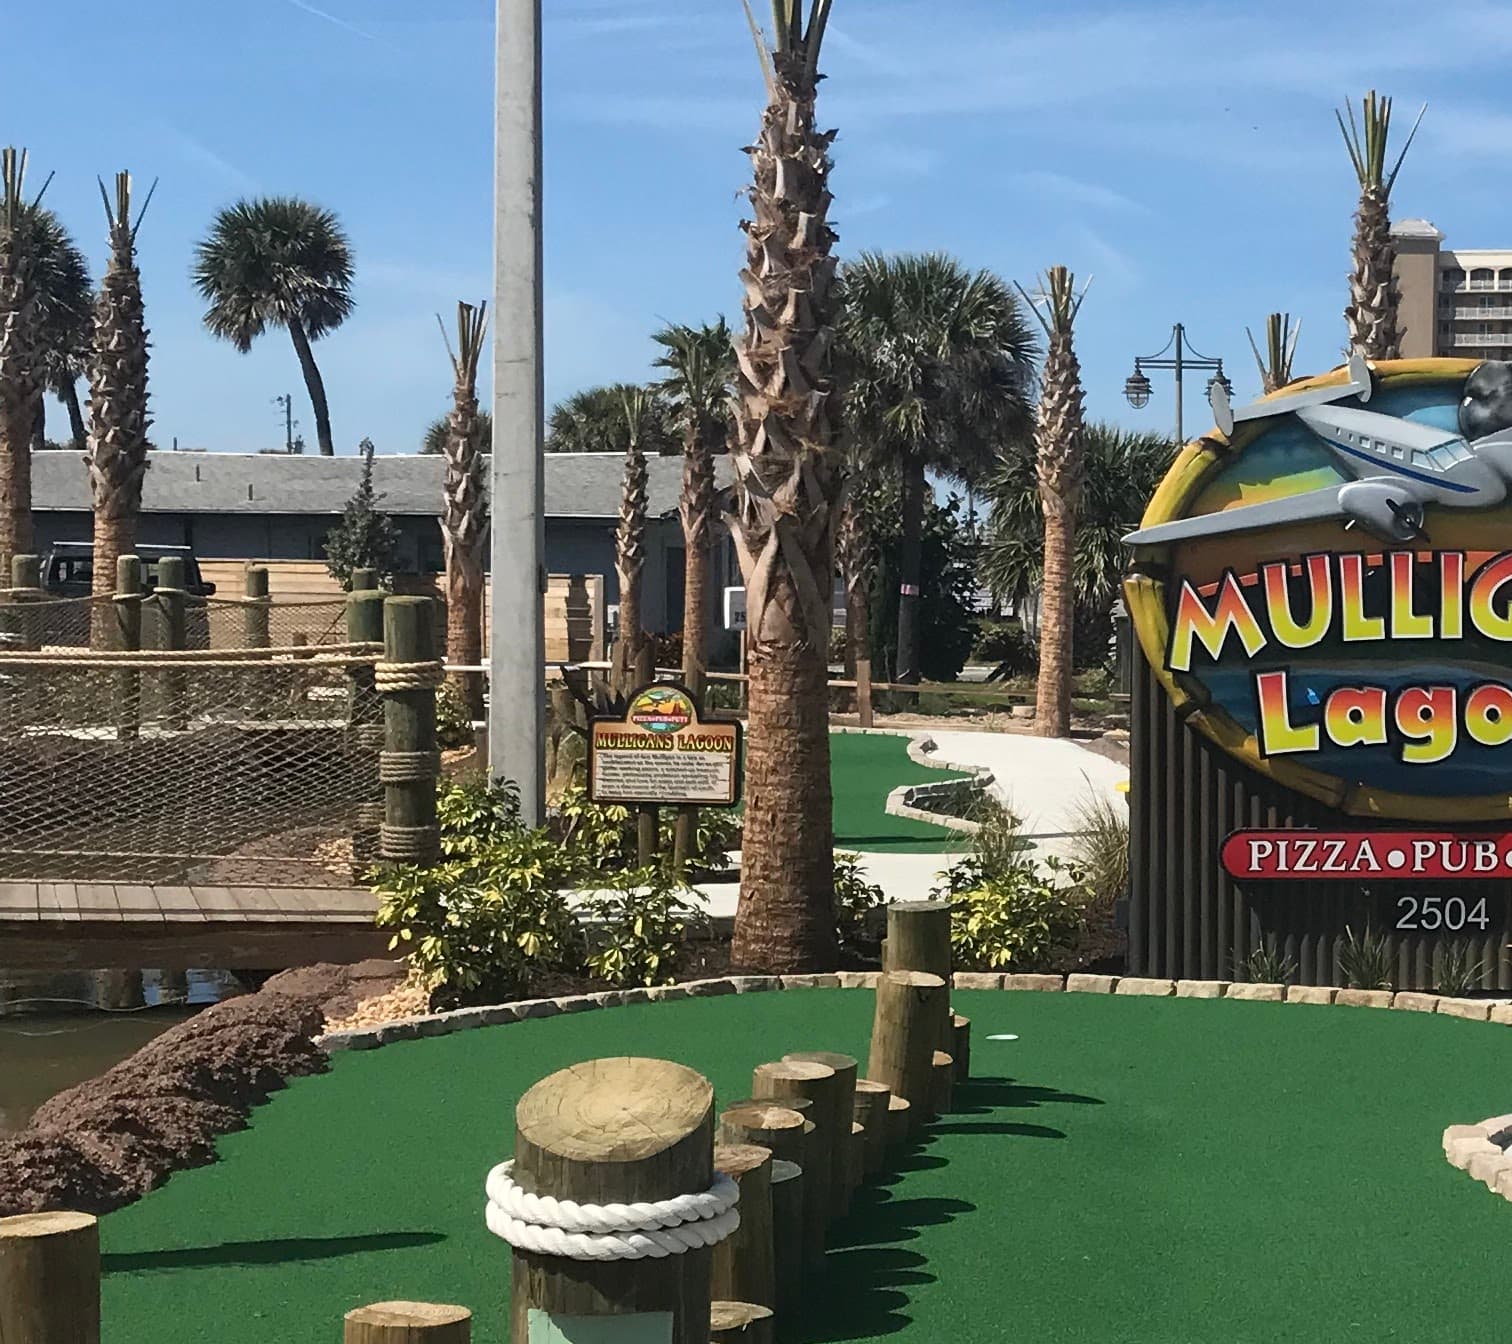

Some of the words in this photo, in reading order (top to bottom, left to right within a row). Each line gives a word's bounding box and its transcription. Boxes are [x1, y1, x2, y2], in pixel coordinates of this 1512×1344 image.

[595, 733, 673, 750] MULLIGANS
[678, 735, 733, 751] LAGOON
[1247, 839, 1382, 872] PIZZA
[1411, 839, 1499, 872] PUB
[1396, 896, 1490, 930] 2504
